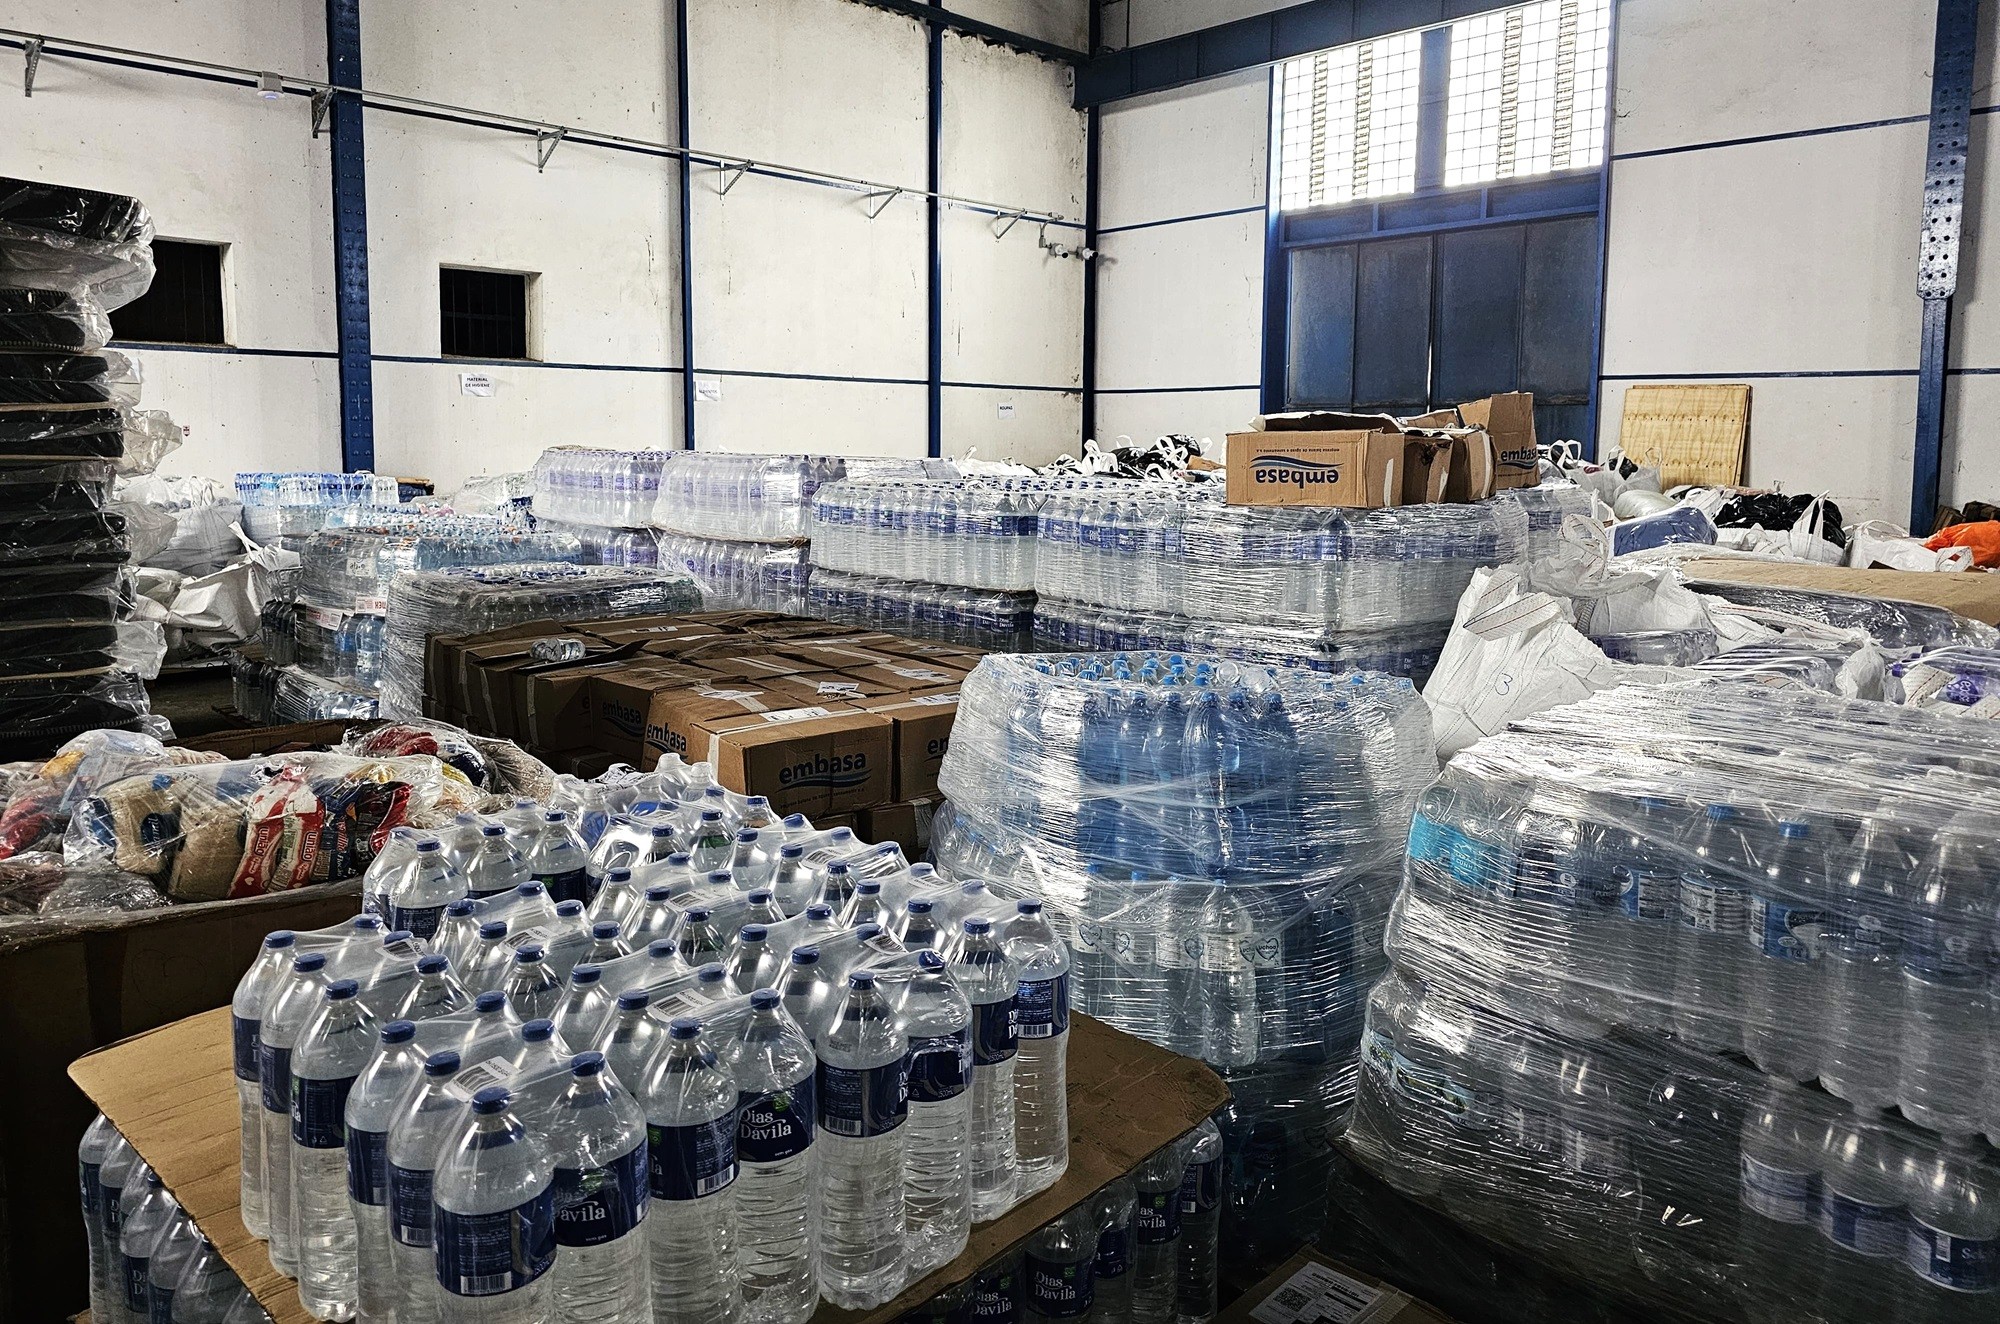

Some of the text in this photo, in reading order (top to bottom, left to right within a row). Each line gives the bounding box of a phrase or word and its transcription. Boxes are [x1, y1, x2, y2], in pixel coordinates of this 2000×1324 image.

[1255, 468, 1339, 489] embasa
[602, 700, 641, 724] embasa
[646, 722, 687, 752] embasa
[778, 752, 867, 785] embasa
[255, 827, 270, 857] união
[302, 831, 318, 862] união
[740, 1107, 774, 1124] Dias
[740, 1121, 792, 1141] Dávila
[1139, 1206, 1153, 1216] as
[1035, 1270, 1063, 1287] Dias
[1035, 1284, 1076, 1302] Dávila
